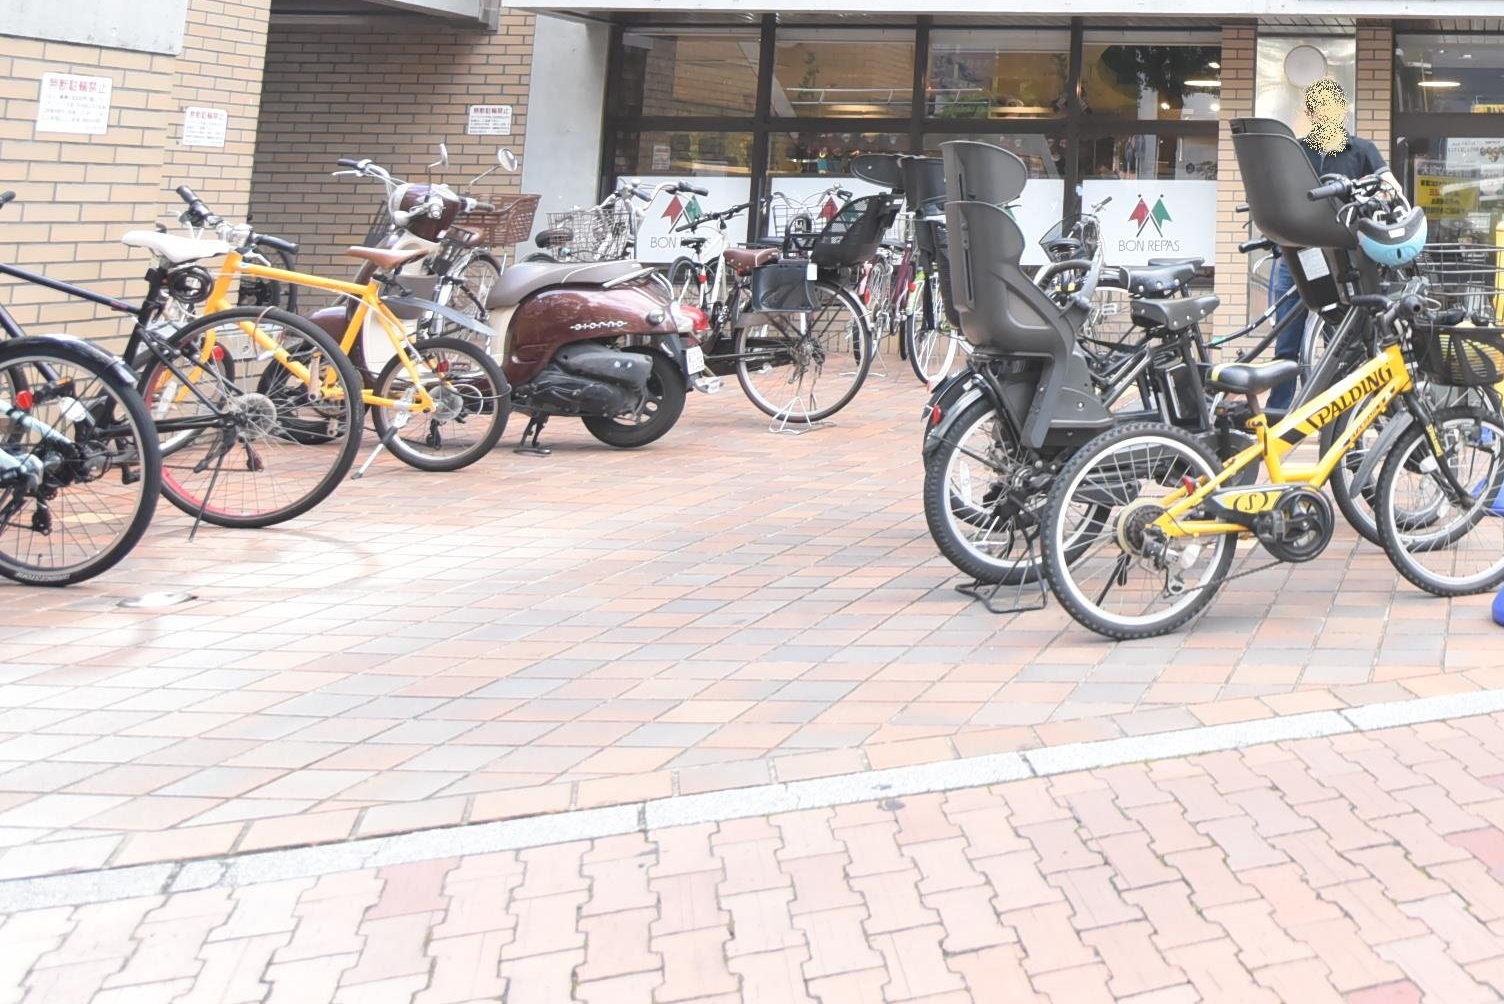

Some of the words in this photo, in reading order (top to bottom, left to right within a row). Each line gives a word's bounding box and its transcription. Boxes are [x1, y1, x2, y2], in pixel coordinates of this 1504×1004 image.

[650, 237, 677, 249] BON
[1118, 239, 1145, 252] BON
[1147, 239, 1181, 252] REPAS
